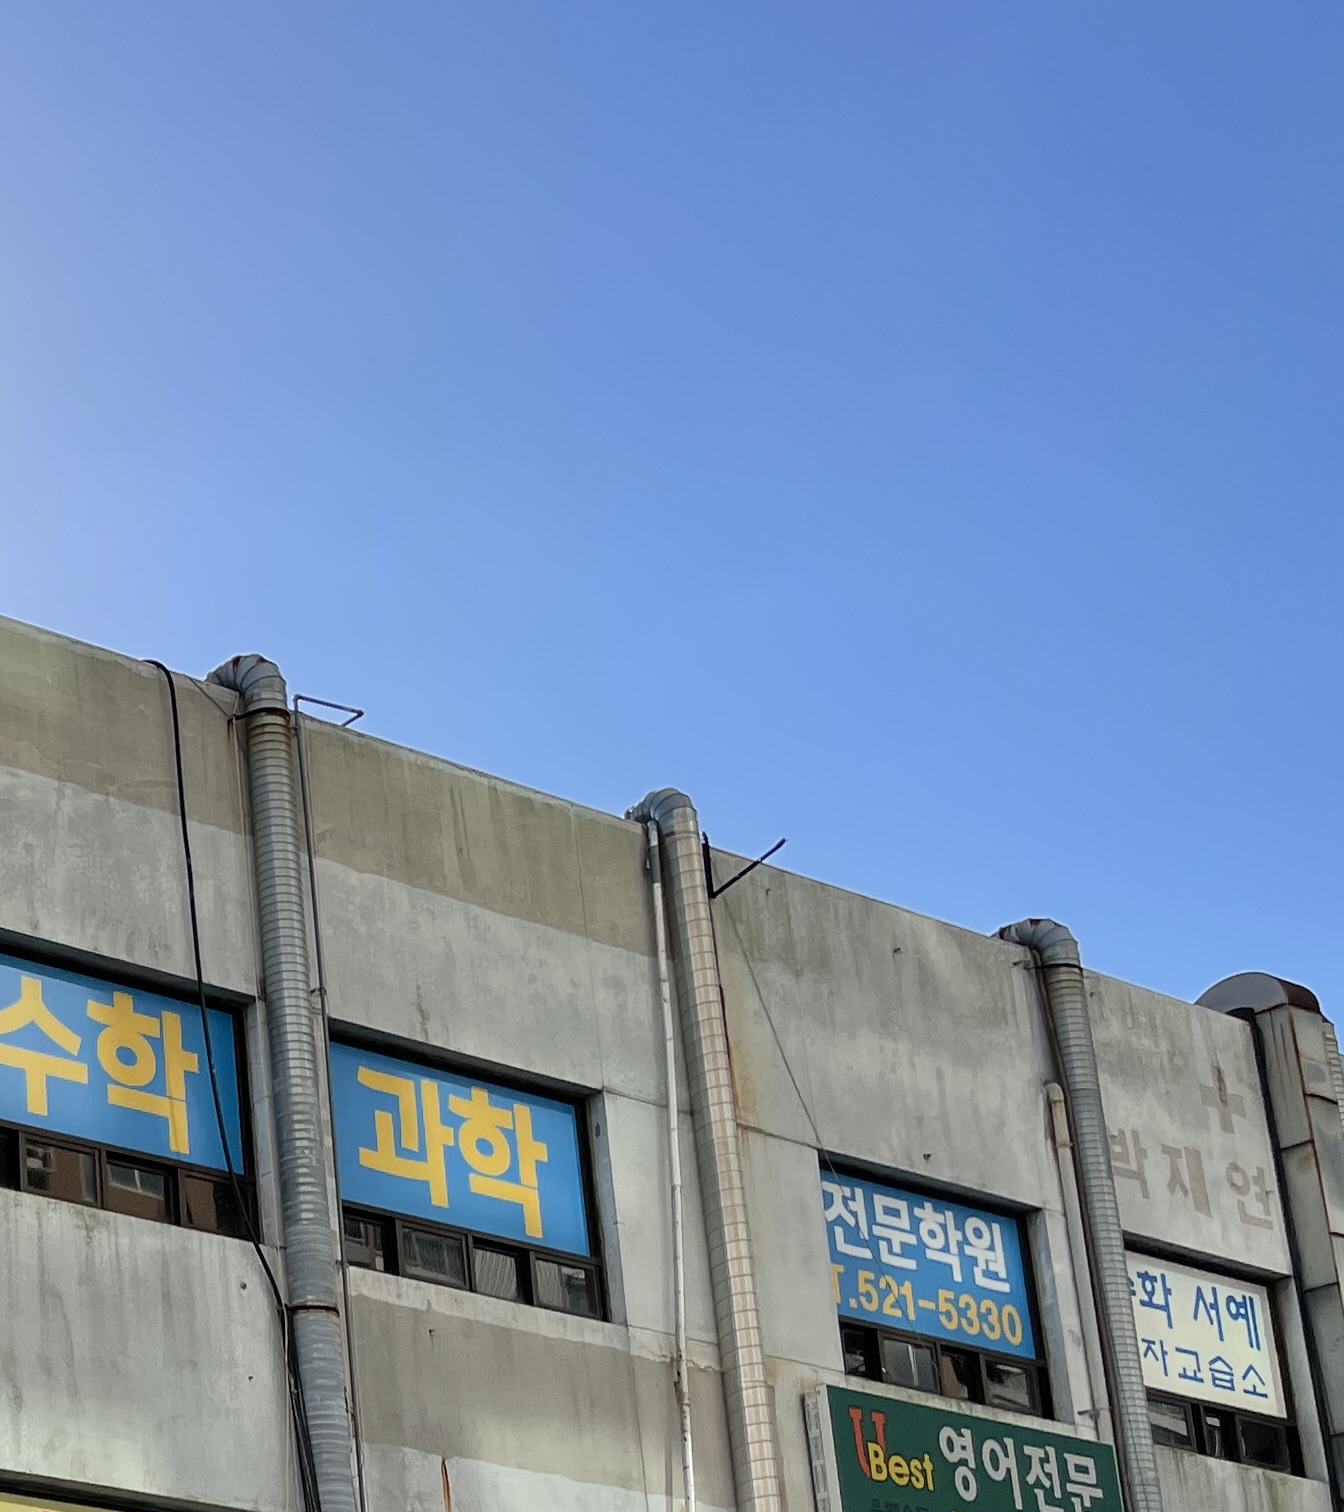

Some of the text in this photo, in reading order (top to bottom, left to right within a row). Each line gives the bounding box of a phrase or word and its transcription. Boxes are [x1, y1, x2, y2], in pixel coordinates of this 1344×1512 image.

[357, 1067, 549, 1239] 과학
[823, 1181, 1012, 1294] 전문학원
[831, 1262, 1023, 1348] T.521-5330
[1128, 1269, 1262, 1353] 화 서예
